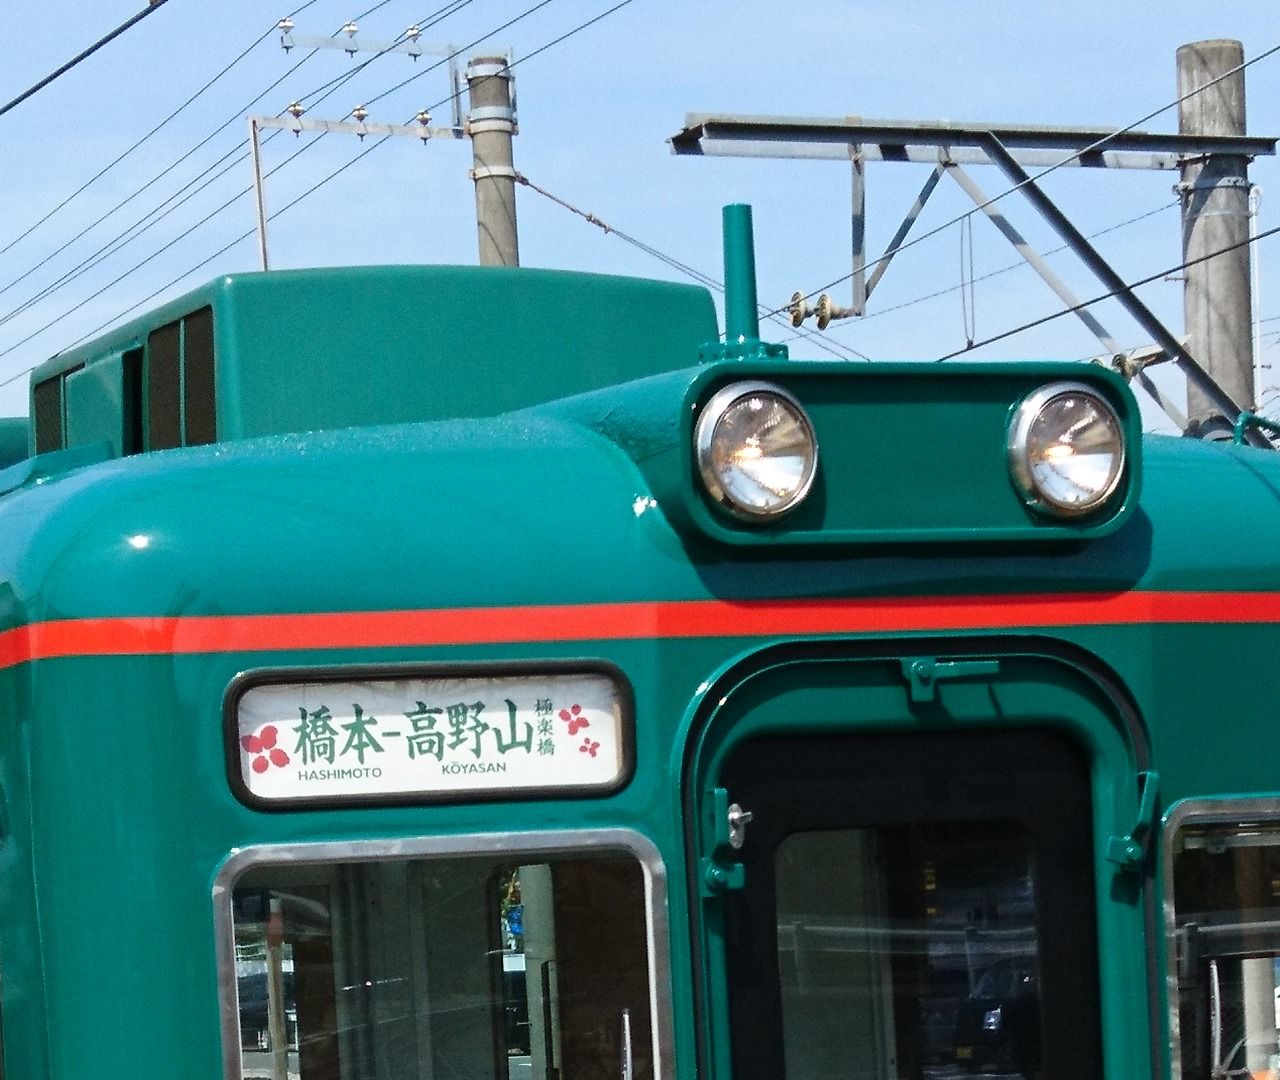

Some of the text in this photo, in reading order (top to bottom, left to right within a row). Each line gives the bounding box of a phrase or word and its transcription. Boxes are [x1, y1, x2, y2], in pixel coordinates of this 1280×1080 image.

[534, 697, 555, 756] 極楽橋
[298, 767, 382, 781] HASHIMOTO
[442, 761, 507, 775] KŌYASAN
